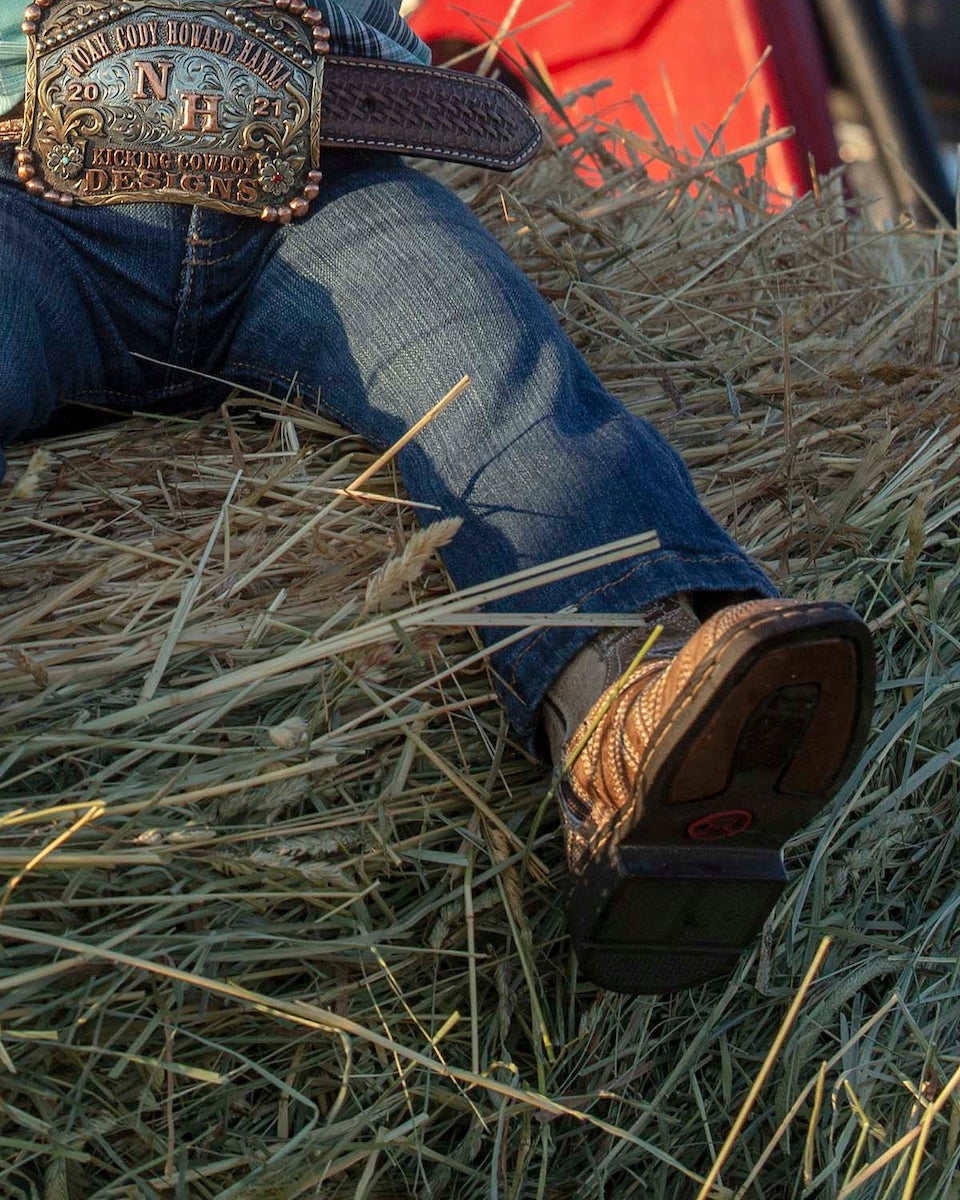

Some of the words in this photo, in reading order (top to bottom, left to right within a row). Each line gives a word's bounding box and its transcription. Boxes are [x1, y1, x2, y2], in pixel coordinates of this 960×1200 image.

[62, 32, 112, 77] NOAH
[116, 21, 158, 51] CODY
[167, 20, 235, 55] HOWARD
[236, 39, 292, 90] HANNA
[68, 83, 99, 101] 20
[133, 60, 174, 100] N
[180, 92, 224, 133] H
[253, 97, 282, 118] 21
[92, 148, 171, 171] KICKING
[178, 151, 256, 176] COWBOY
[83, 168, 258, 203] DESIGNS
